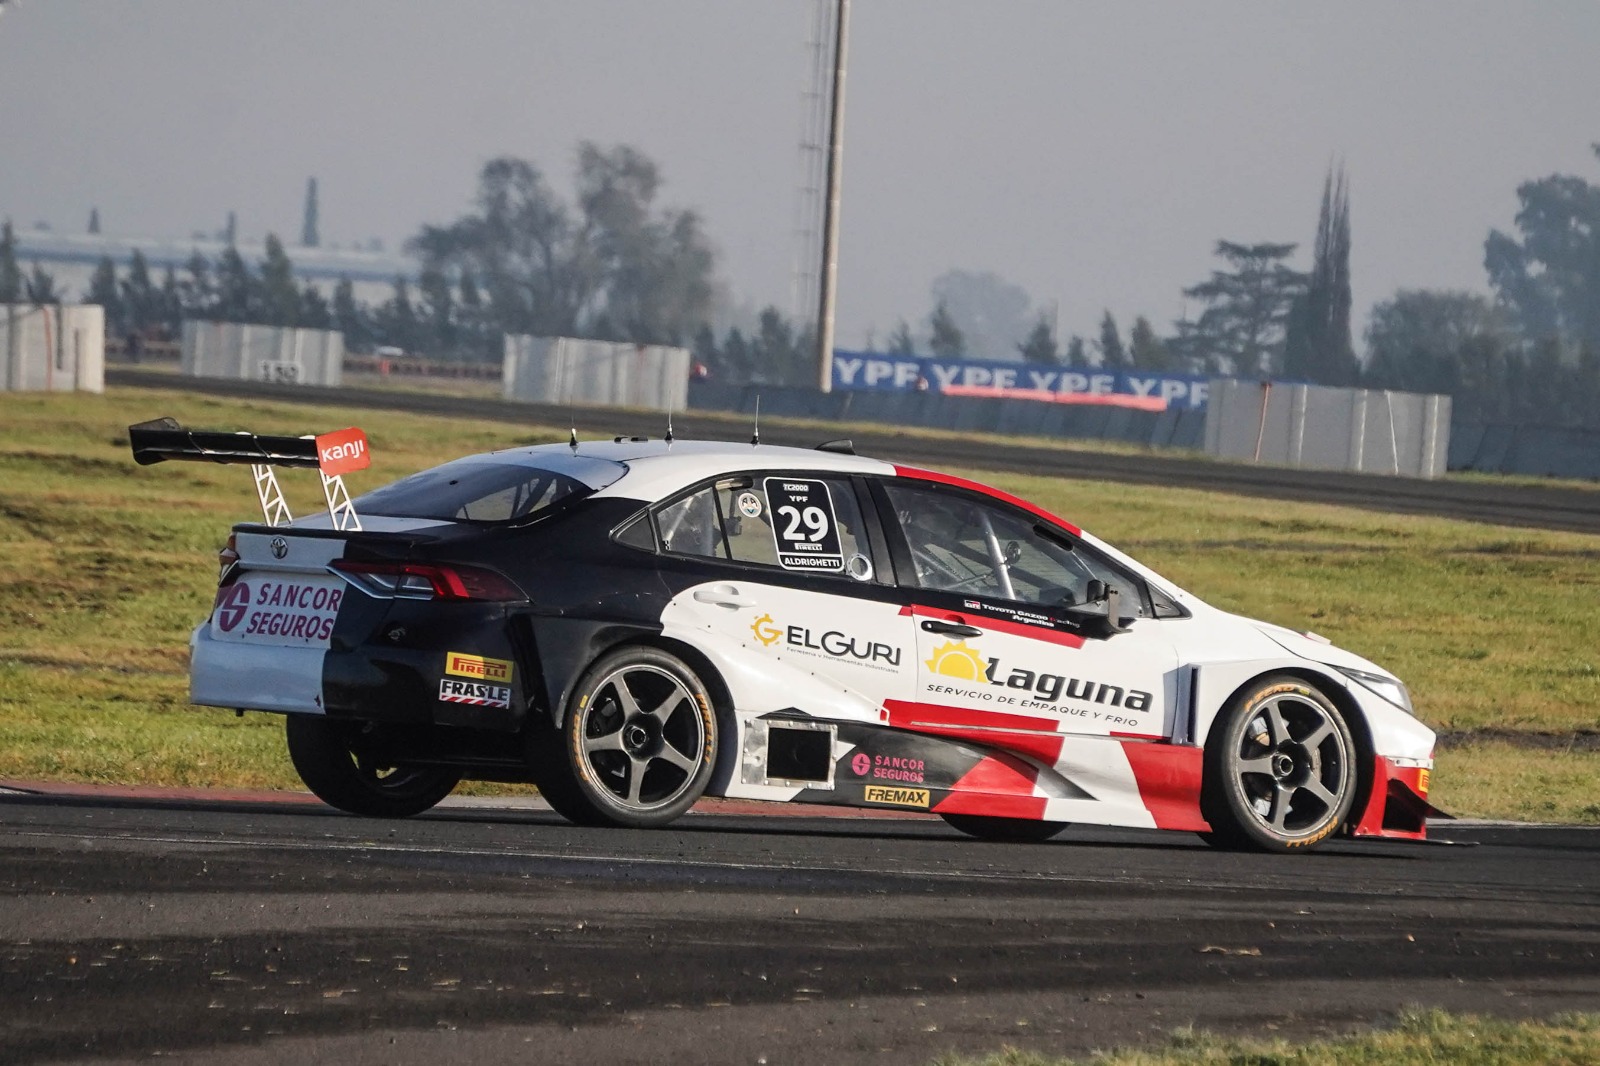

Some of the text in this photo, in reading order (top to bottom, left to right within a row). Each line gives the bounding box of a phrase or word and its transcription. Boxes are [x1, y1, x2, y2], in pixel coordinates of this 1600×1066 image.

[835, 357, 920, 387] YPF
[321, 439, 364, 463] kanji
[783, 483, 809, 492] TC2000
[777, 505, 829, 542] 29
[784, 557, 840, 567] ALDRIGHETTI
[256, 583, 342, 612] SANCOR
[246, 612, 334, 640] SEGUROS
[1012, 614, 1055, 627] Argentina
[452, 657, 507, 678] PIRELLI
[985, 657, 1153, 713] Laguna
[927, 684, 1138, 727] SERVICIO DE EMPAQUE Y FRIO
[696, 693, 713, 764] PIRELLI
[873, 767, 924, 783] SEGUROS
[874, 755, 924, 770] SANCOR
[867, 788, 926, 804] FREMAX
[1286, 816, 1338, 848] PIRELLI
